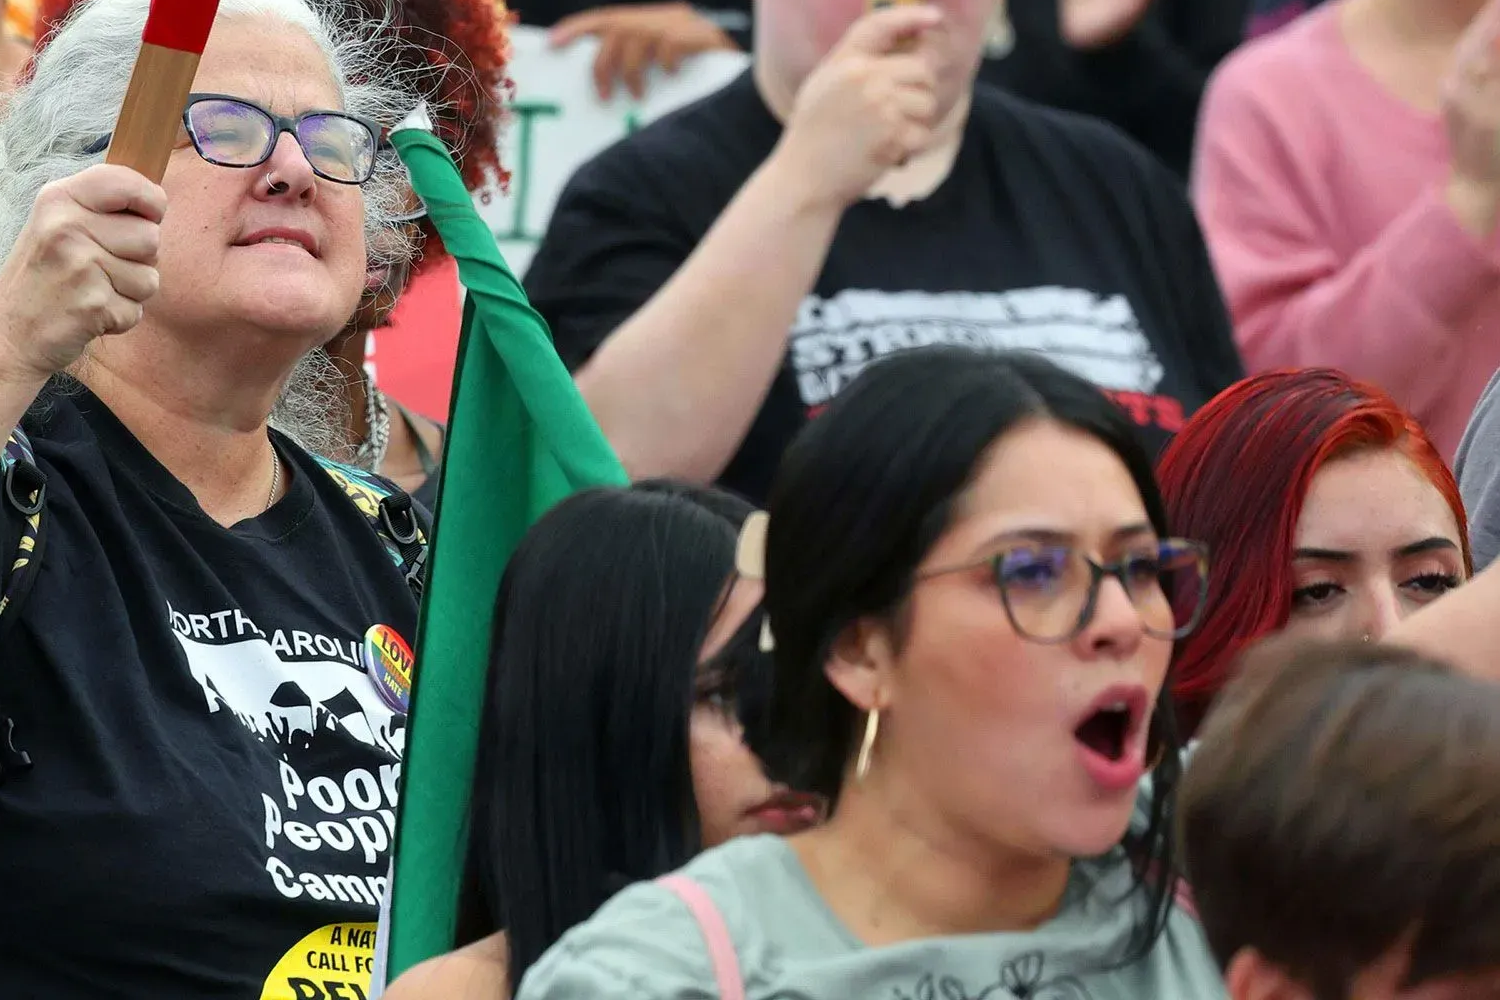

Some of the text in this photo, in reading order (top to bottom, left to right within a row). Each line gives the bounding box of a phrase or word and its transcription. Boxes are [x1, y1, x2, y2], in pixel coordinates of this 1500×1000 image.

[383, 672, 403, 699] HATE
[330, 926, 342, 945] A
[306, 950, 350, 972] CALL
